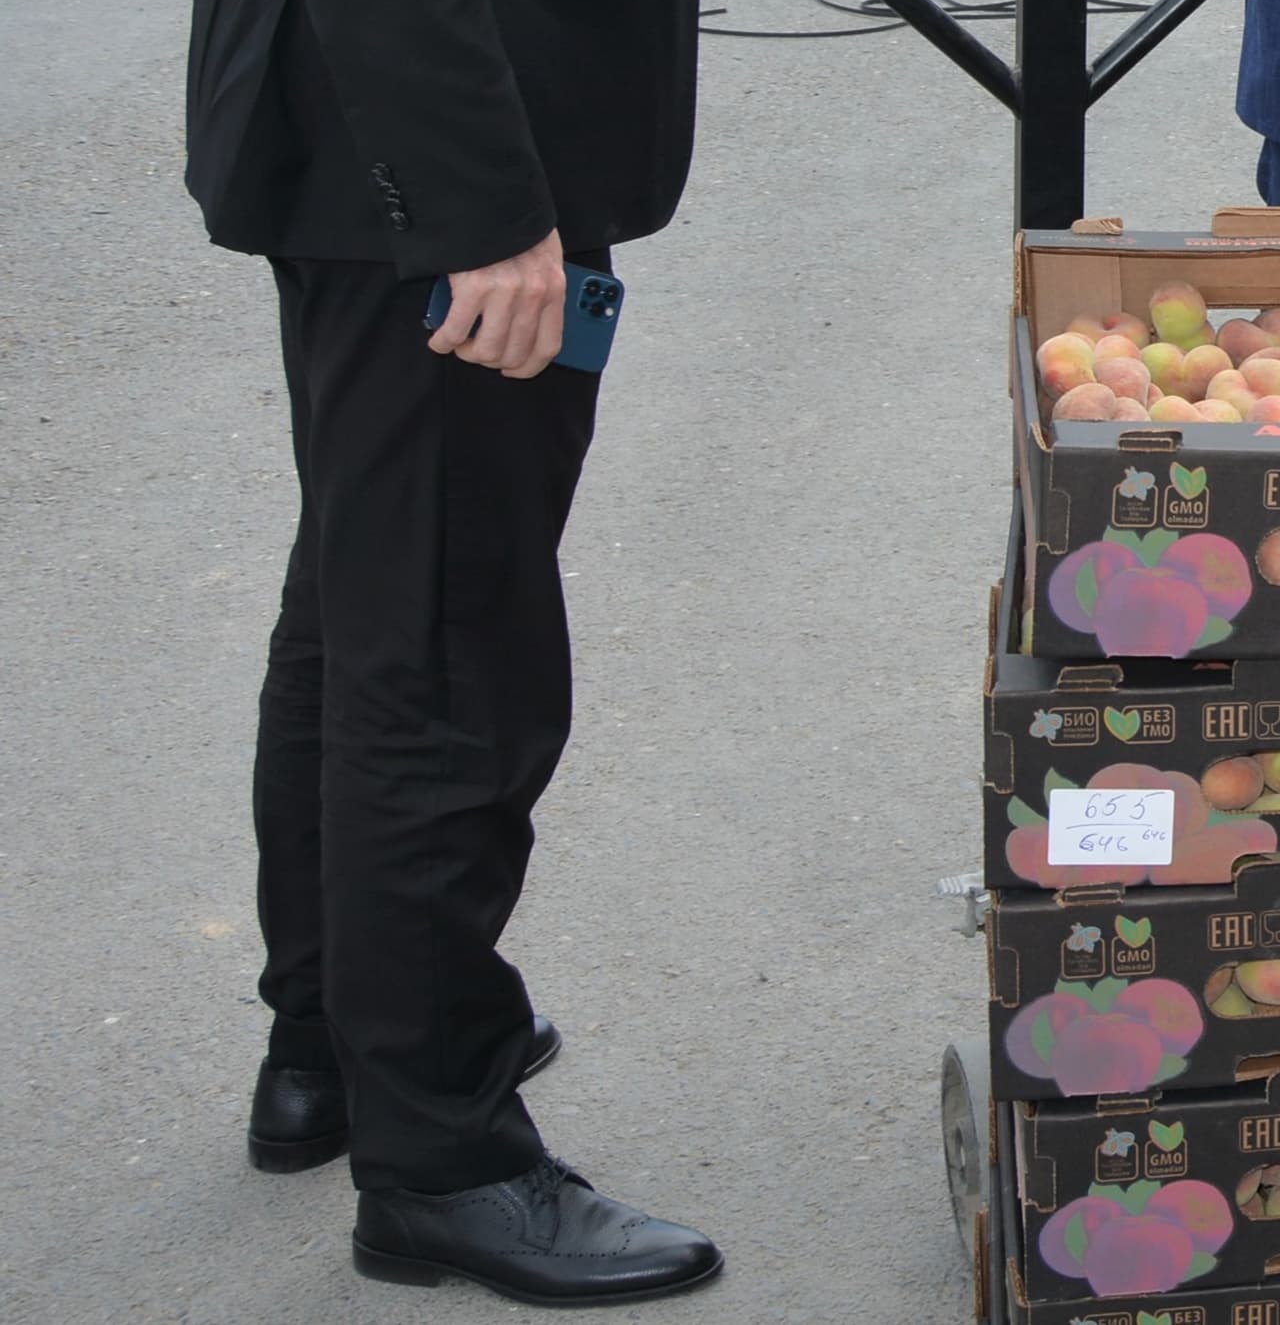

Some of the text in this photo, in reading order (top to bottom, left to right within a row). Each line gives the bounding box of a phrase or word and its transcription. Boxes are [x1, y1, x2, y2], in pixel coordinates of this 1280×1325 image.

[1169, 500, 1204, 515] GMO
[1063, 712, 1095, 727] БИО
[1143, 709, 1171, 723] БЕЗ
[1206, 705, 1249, 738] EAC
[1143, 724, 1171, 738] ГМО
[1211, 915, 1252, 947] EAC
[1117, 950, 1150, 963] GMO
[1150, 1153, 1182, 1166] GMO
[1174, 1311, 1201, 1325] БЕЗ
